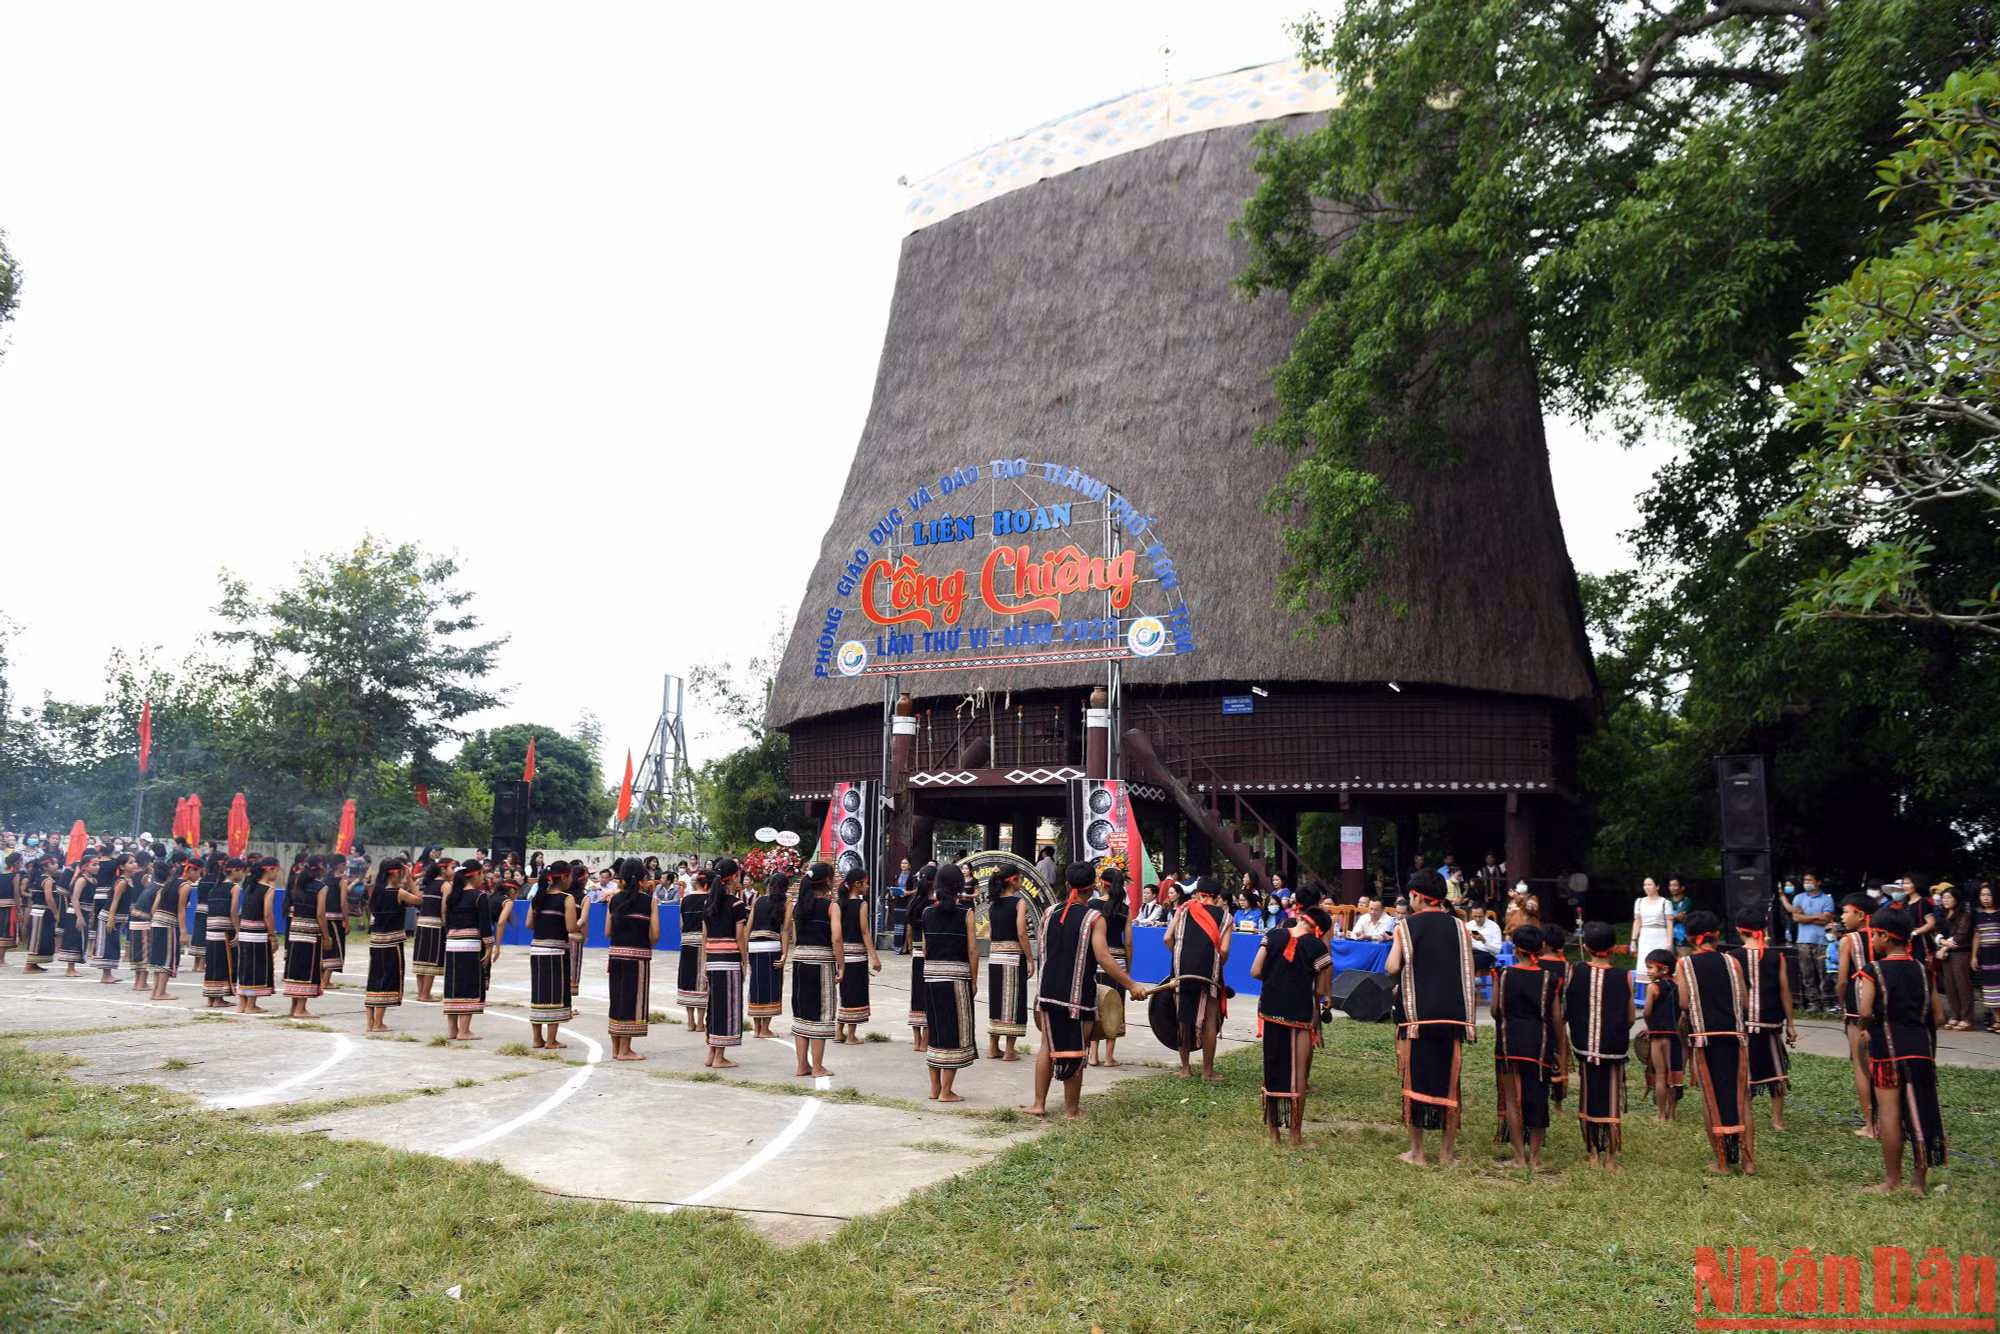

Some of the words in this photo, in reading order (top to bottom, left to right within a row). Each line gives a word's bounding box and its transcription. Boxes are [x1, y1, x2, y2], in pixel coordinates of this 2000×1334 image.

[912, 512, 976, 546] LIÊN
[993, 502, 1073, 536] HOAN
[815, 606, 843, 678] PHÒNG
[837, 549, 870, 597] GIÁO
[869, 508, 905, 546] DỤC
[907, 484, 934, 512] VÀ
[940, 466, 980, 495] ĐÀO
[990, 458, 1027, 480] TẠO
[1043, 462, 1108, 503] THÀNH
[1110, 495, 1157, 537] PHỐ
[1145, 541, 1181, 592] KON
[1168, 602, 1196, 655] TUM
[861, 554, 968, 630] Cồng
[980, 545, 1140, 620] Chiêng
[877, 626, 914, 656] LẦN
[922, 622, 962, 653] THỨ
[969, 627, 988, 649] VI
[1004, 620, 1053, 647] NĂM
[1063, 617, 1119, 642] 2022
